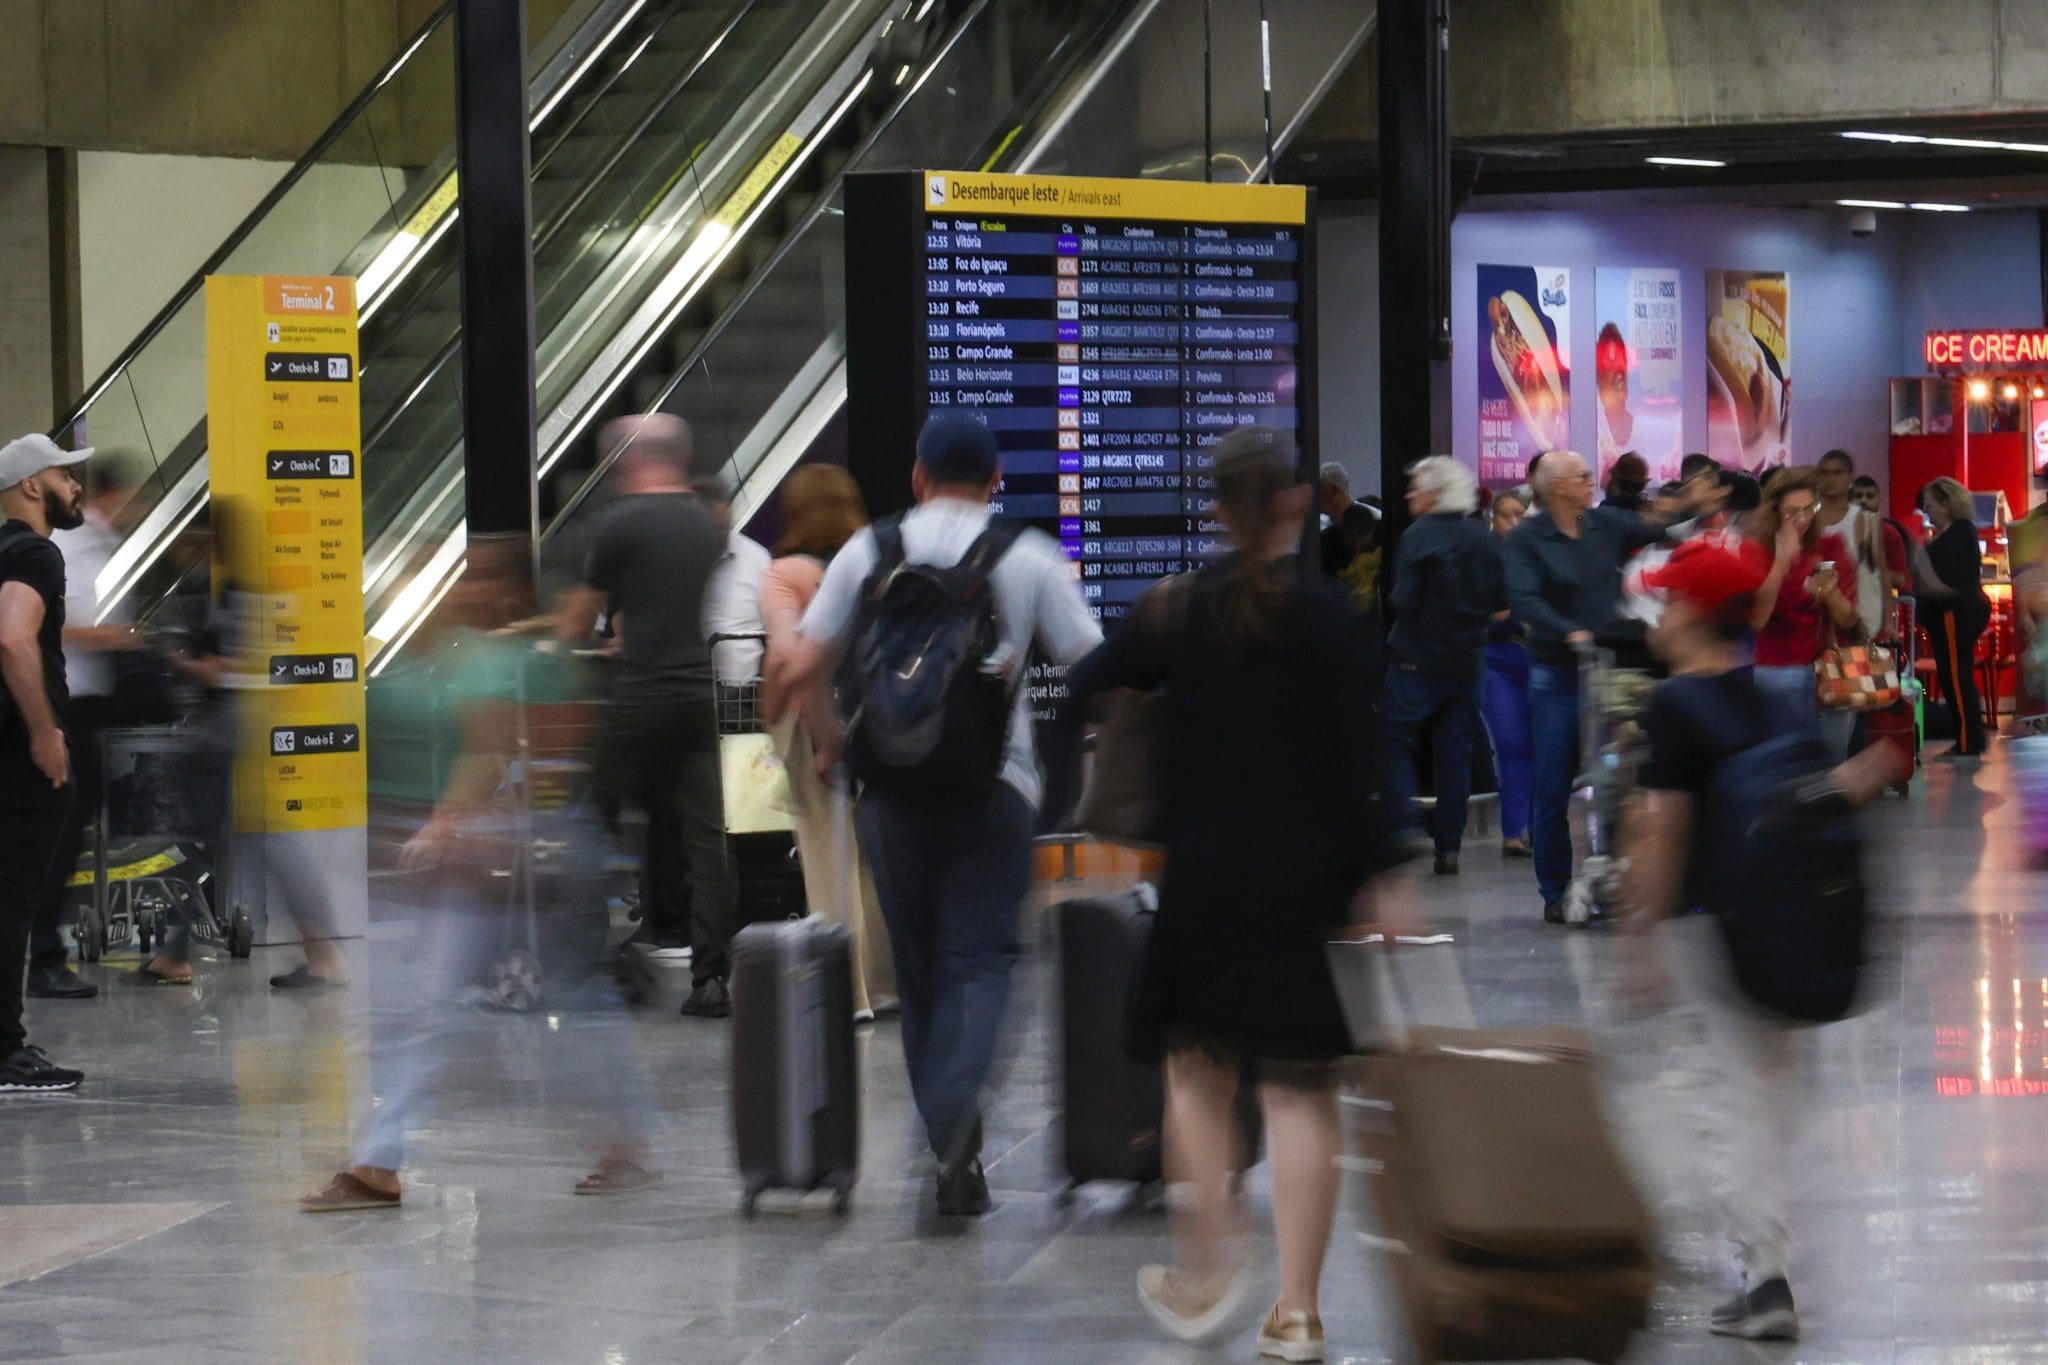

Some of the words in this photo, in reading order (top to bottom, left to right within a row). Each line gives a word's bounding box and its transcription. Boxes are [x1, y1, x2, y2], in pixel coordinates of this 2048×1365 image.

[952, 181, 1030, 206] Desembarque
[1033, 184, 1059, 202] leste
[1068, 191, 1101, 205] Arrivals
[1103, 193, 1121, 206] east
[928, 236, 948, 248] 12:55
[956, 235, 981, 249] Vitória
[1195, 242, 1232, 254] Confirmado
[1236, 244, 1254, 255] Oeste
[928, 258, 948, 270] 13:05
[956, 257, 968, 270] Foz
[970, 257, 980, 270] do
[982, 258, 1007, 274] Iguaçu
[1082, 261, 1098, 272] 1171
[1195, 263, 1232, 276] Confirmado
[1236, 265, 1253, 277] Leste
[928, 280, 949, 293] 13:10
[956, 280, 976, 292] Porto
[978, 280, 1005, 296] Seguro
[1195, 284, 1232, 297] Confirmado
[1237, 285, 1255, 297] Oeste
[281, 292, 322, 310] Terminal
[325, 285, 335, 311] 2
[928, 303, 949, 315] 13:10
[956, 301, 979, 315] Recife
[1082, 304, 1098, 316] 2748
[1196, 305, 1221, 317] Previsto
[928, 325, 949, 337] 13:10
[957, 323, 1005, 339] Florianópolis
[1196, 326, 1233, 339] Confirmado
[1237, 328, 1255, 339] Oeste
[929, 347, 949, 359] 13:15
[957, 346, 983, 362] Campo
[985, 346, 1013, 359] Grande
[1196, 347, 1233, 359] Confirmado
[1237, 349, 1253, 360] Leste
[1927, 334, 1963, 363] ICE
[1970, 334, 2048, 363] CREAM
[289, 361, 313, 375] Check-in
[313, 360, 320, 374] B
[929, 369, 949, 381] 13:15
[957, 368, 974, 381] Belo
[976, 368, 1013, 382] Horizonte
[930, 391, 950, 404] 13:15
[957, 390, 984, 406] Campo
[986, 391, 1013, 404] Grande
[1083, 391, 1099, 403] 3129
[1102, 390, 1131, 406] QTR7272
[1197, 391, 1233, 404] Confirmado
[1238, 392, 1256, 403] Oeste
[1083, 412, 1099, 425] 1321
[1197, 412, 1233, 424] Confirmado
[1083, 434, 1099, 446] 1401
[1103, 433, 1130, 445] AFR2004
[1133, 433, 1162, 445] ARG7457
[290, 460, 314, 471] Check-in
[315, 458, 320, 471] C
[1083, 454, 1100, 467] 3389
[1103, 454, 1132, 467] ARG8051
[1135, 454, 1164, 470] QTR5145
[1083, 477, 1100, 489] 1647
[1103, 476, 1132, 488] ARG7683
[1135, 476, 1164, 488] AVA4756
[1084, 499, 1100, 511] 1417
[1084, 521, 1101, 533] 3361
[1084, 541, 1101, 553] 4571
[1084, 564, 1101, 576] 1637
[1085, 585, 1101, 598] 3839
[293, 664, 318, 676] Check-in
[319, 661, 325, 675] D
[1030, 666, 1040, 679] no
[304, 734, 328, 746] Check-in
[329, 731, 334, 745] E
[286, 799, 302, 811] GRU
